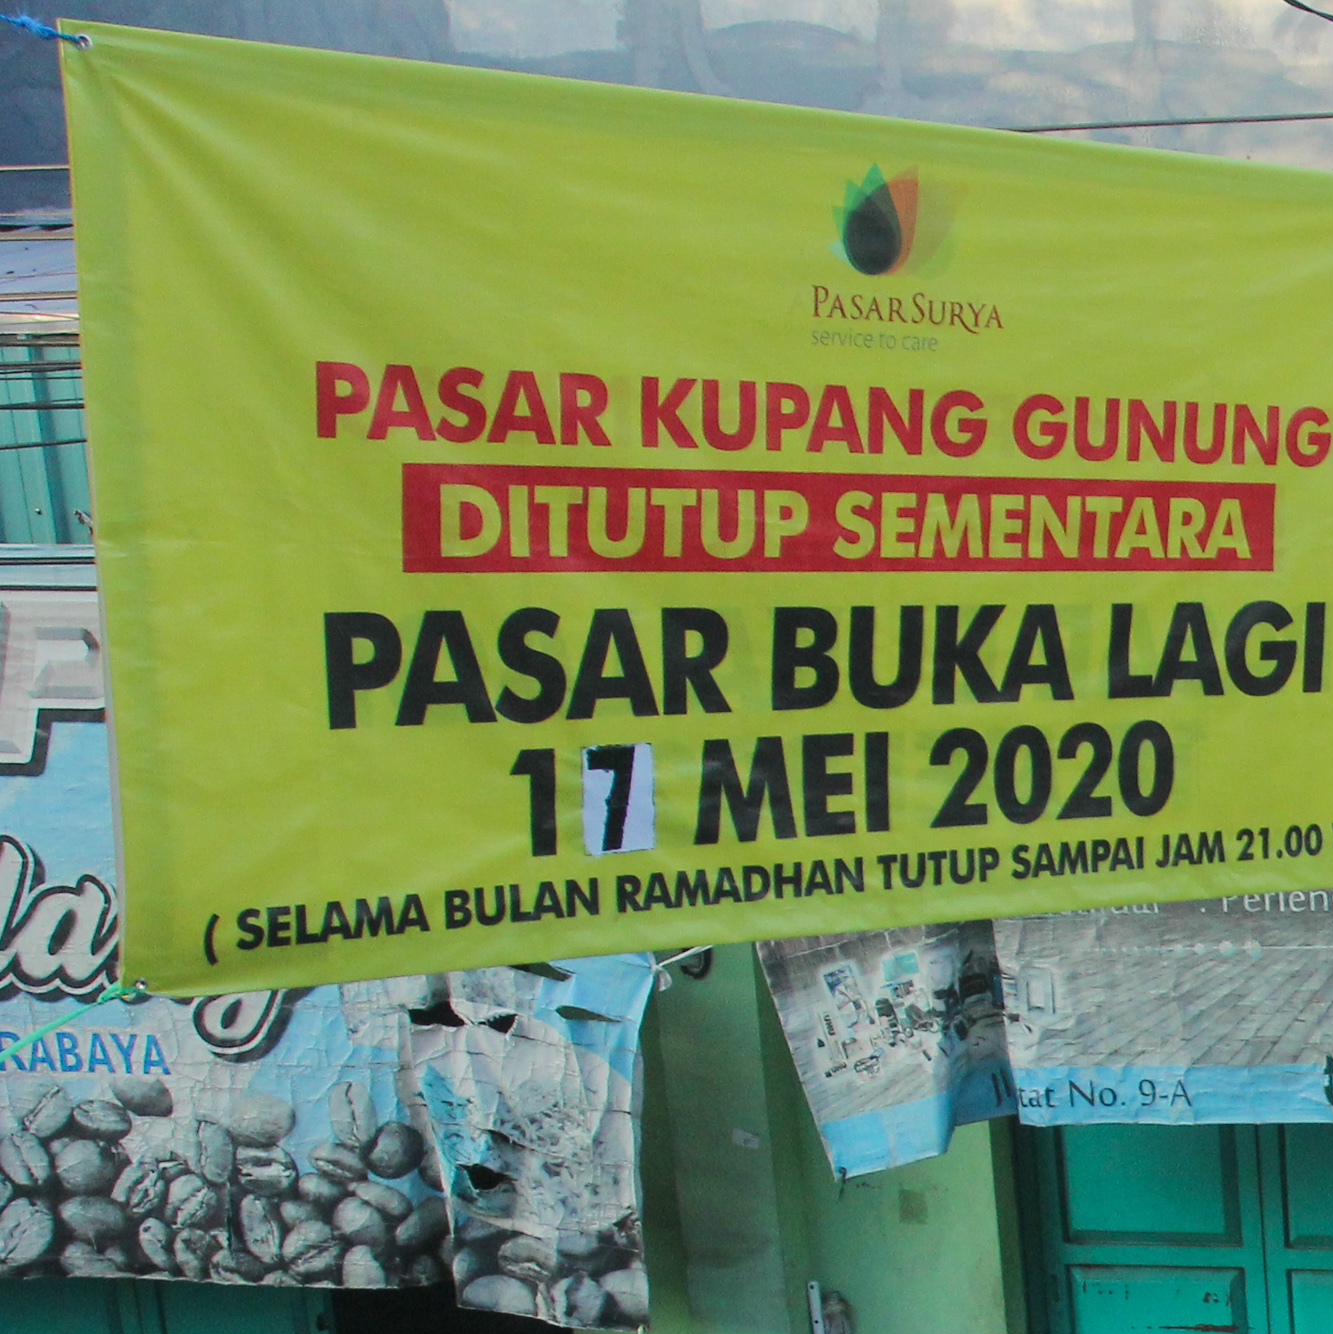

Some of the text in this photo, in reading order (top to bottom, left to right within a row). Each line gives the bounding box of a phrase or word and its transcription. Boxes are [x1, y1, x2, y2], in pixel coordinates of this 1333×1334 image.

[811, 328, 939, 352] service to care
[315, 361, 1333, 468] PASAR KUPANG GUNUNG
[439, 483, 1252, 560] DITUTUP SEMENTARA
[323, 600, 1327, 730] PASAR BUKA LAGI
[510, 719, 1176, 857] 17 MEI 2020
[444, 877, 600, 931] BULAN
[616, 856, 865, 914] RAMADHAN
[876, 846, 1001, 889] TUTUP
[1011, 836, 1145, 880] SAMPAI
[1155, 830, 1226, 868] JAM
[1235, 822, 1323, 862] 21.00
[1068, 1079, 1128, 1108] No.
[1137, 1079, 1194, 1108] 9-A
